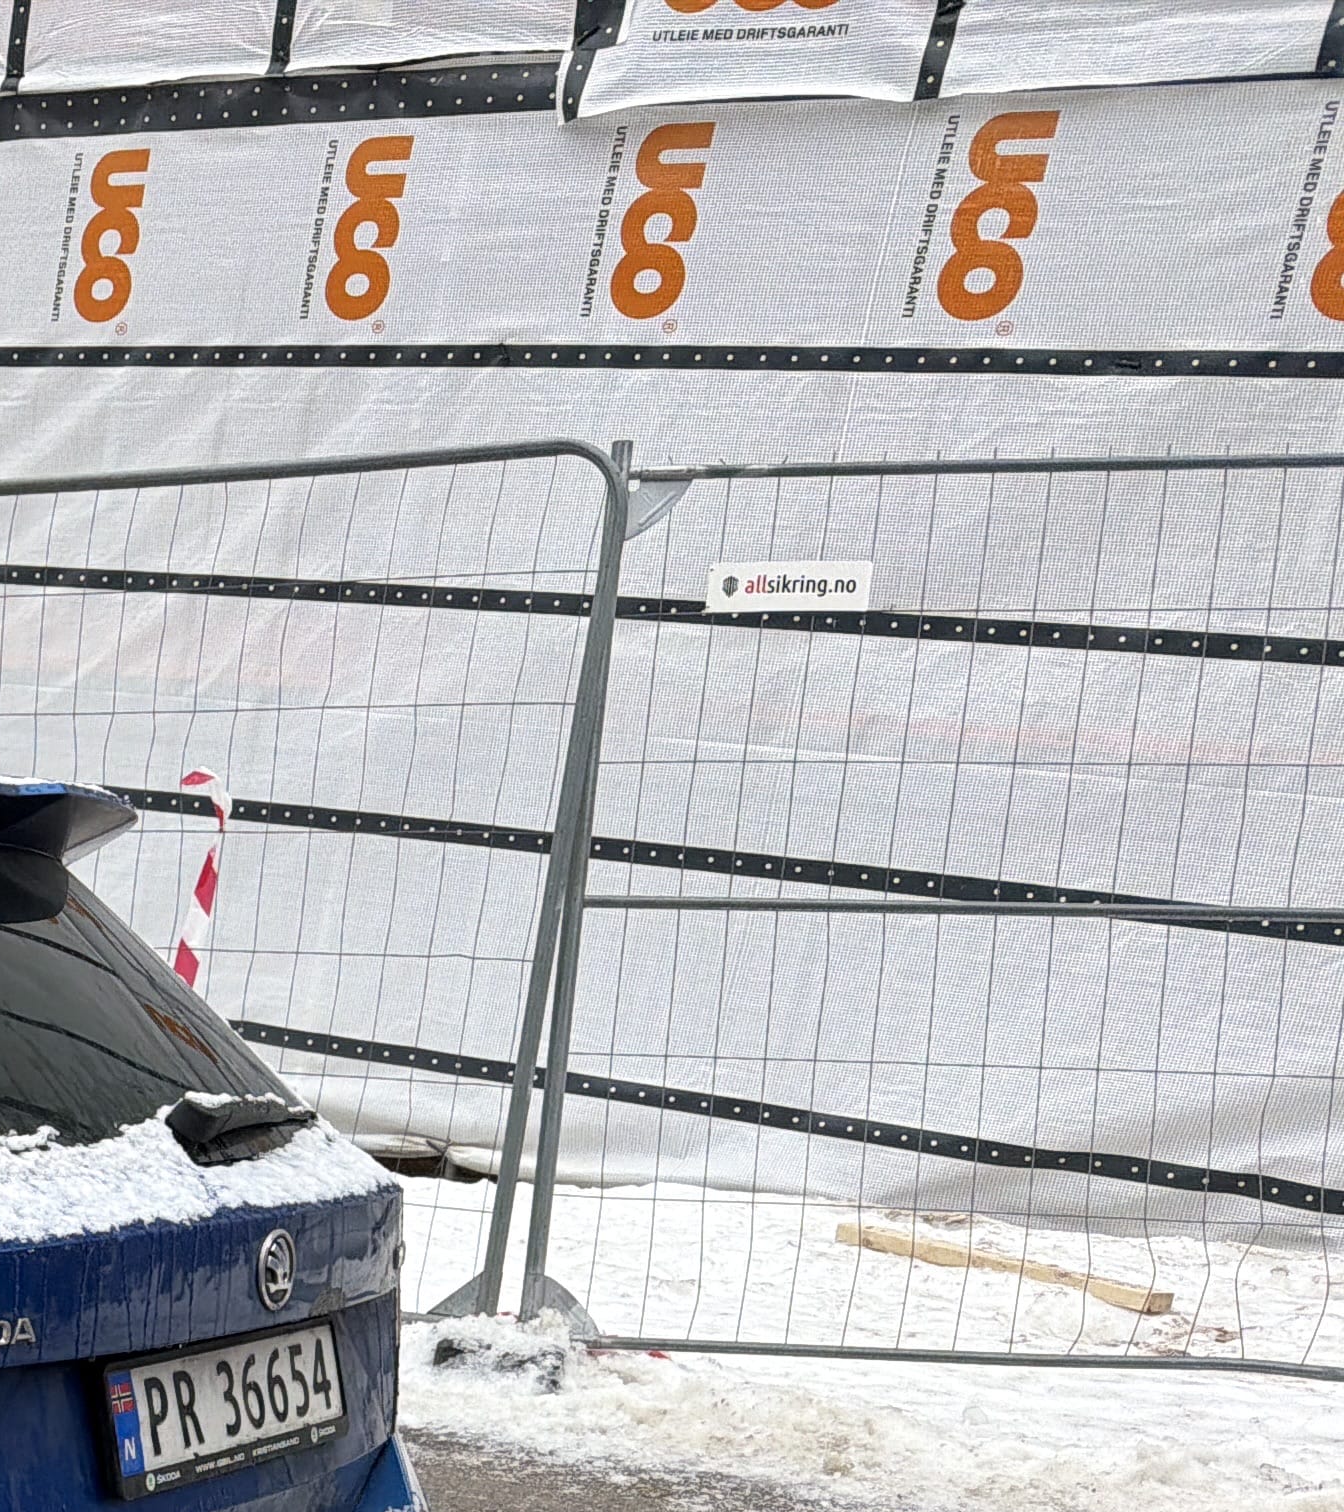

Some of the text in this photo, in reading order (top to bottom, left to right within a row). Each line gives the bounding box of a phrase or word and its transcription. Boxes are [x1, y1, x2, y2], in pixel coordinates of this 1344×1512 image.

[652, 23, 850, 42] UTLEIE MED DRIFTSGARANTI
[51, 152, 83, 322] UTLEIE MED DRIFTSGARANTI
[73, 148, 151, 324] UCO
[299, 139, 339, 319] UTLEIE MED DRIFTSGARANTI
[325, 135, 414, 321] UCO
[580, 126, 628, 317] UTLEIE MED DRIFTSGARANTI
[610, 121, 716, 319] UCO
[902, 115, 961, 318] UTLEIE MED DRIFTSGARANTI
[937, 110, 1061, 321] UCO
[1269, 100, 1341, 321] UTLEIE MED DRIFTSGARANTI
[744, 574, 857, 597] allsikring.no
[123, 1437, 136, 1461] N
[144, 1338, 331, 1457] PR 36654
